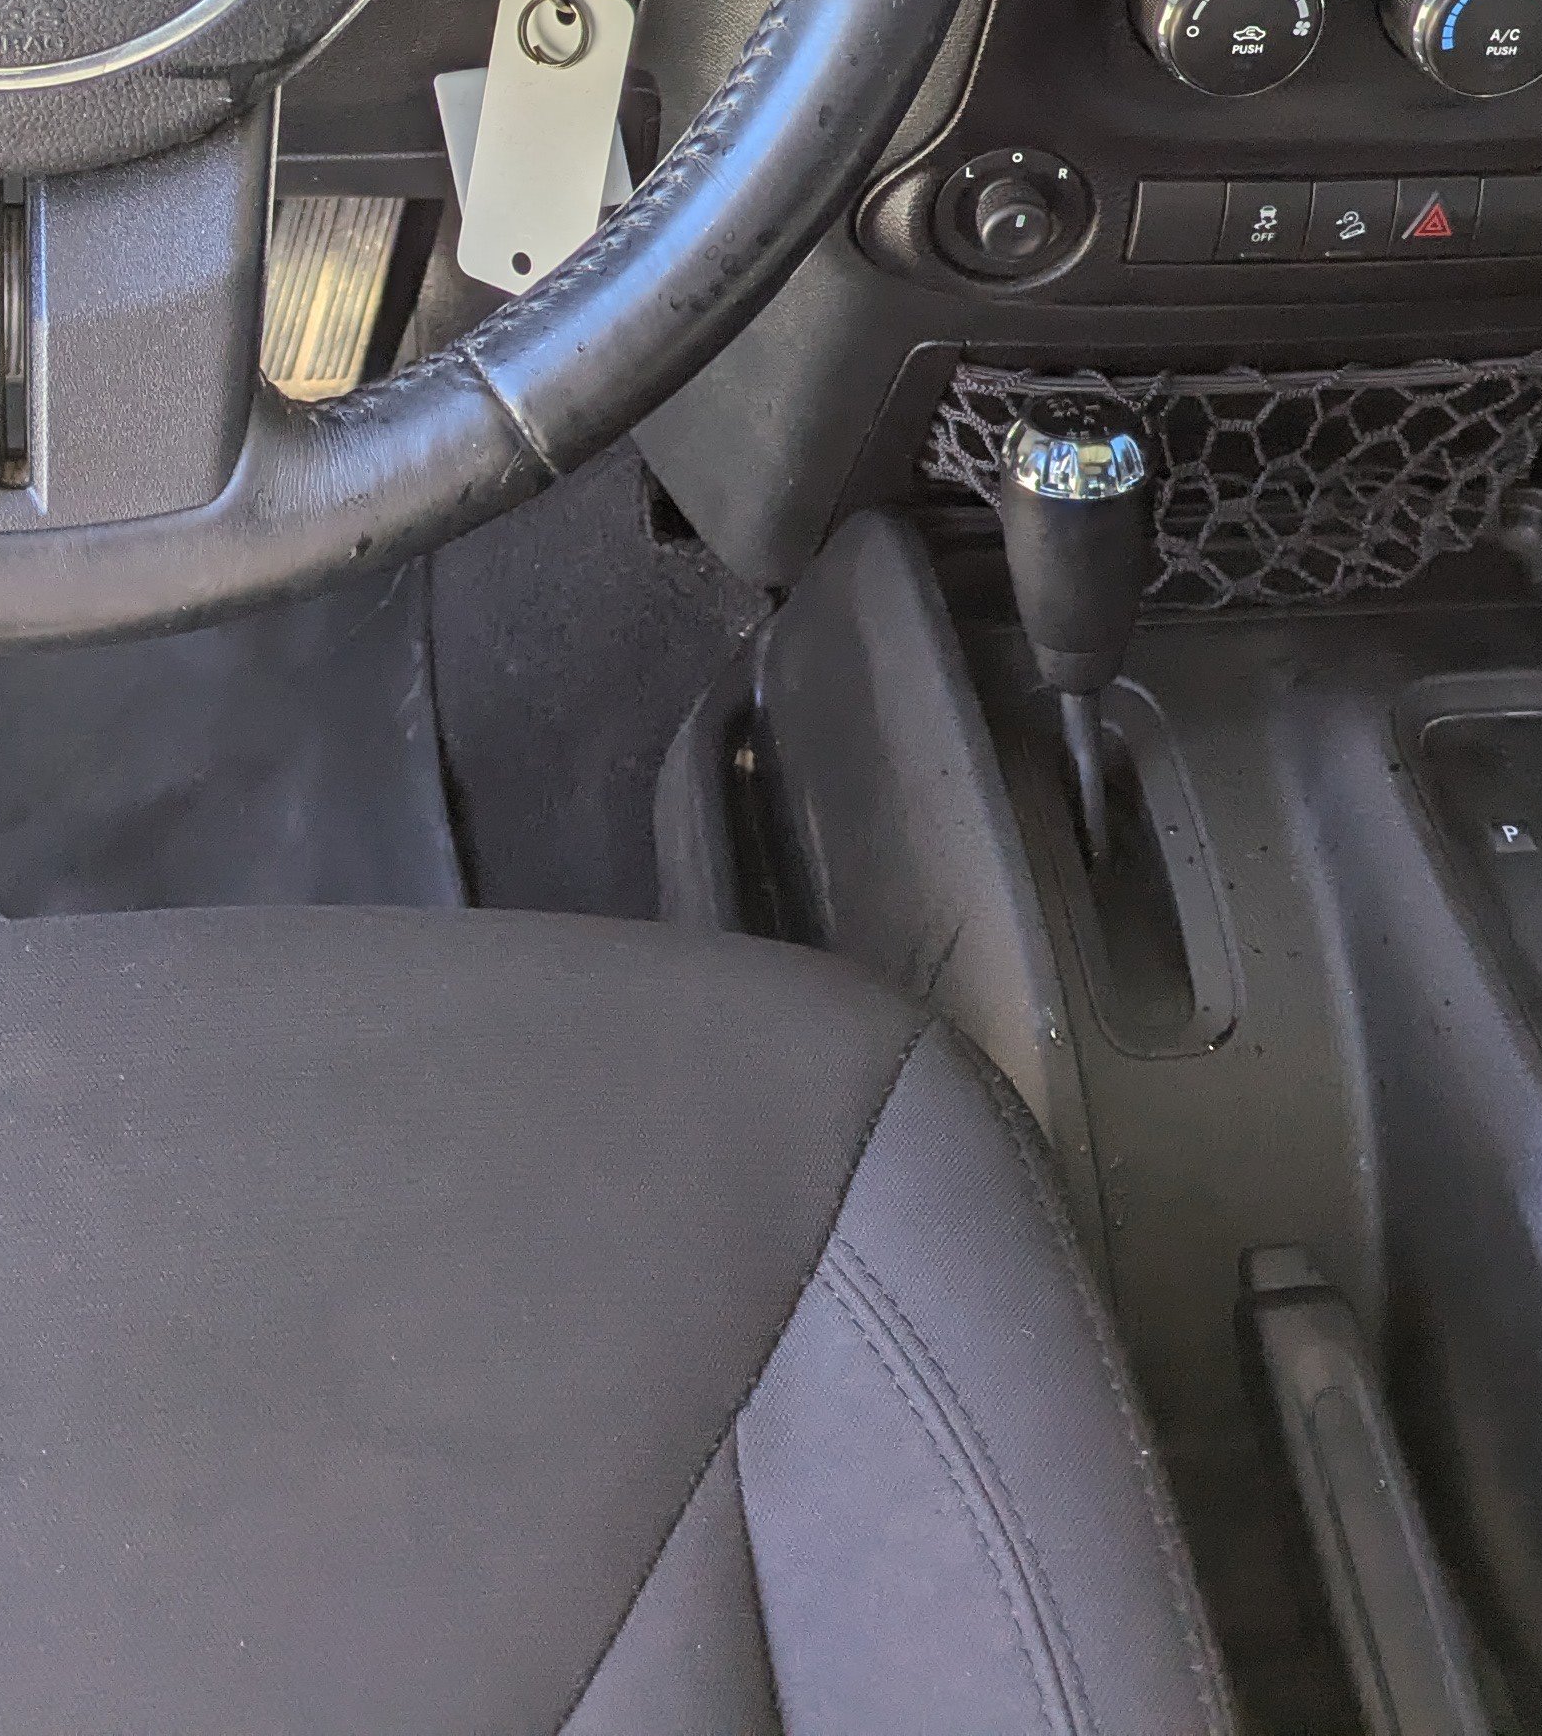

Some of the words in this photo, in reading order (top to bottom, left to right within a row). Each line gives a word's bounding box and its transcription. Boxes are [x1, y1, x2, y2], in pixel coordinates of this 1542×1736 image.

[1489, 28, 1521, 43] A/C
[1231, 44, 1264, 55] PUSH
[1485, 45, 1518, 57] PUSH
[965, 166, 974, 178] L
[1057, 168, 1069, 180] R
[1251, 232, 1275, 243] OFF
[1502, 824, 1520, 843] P
